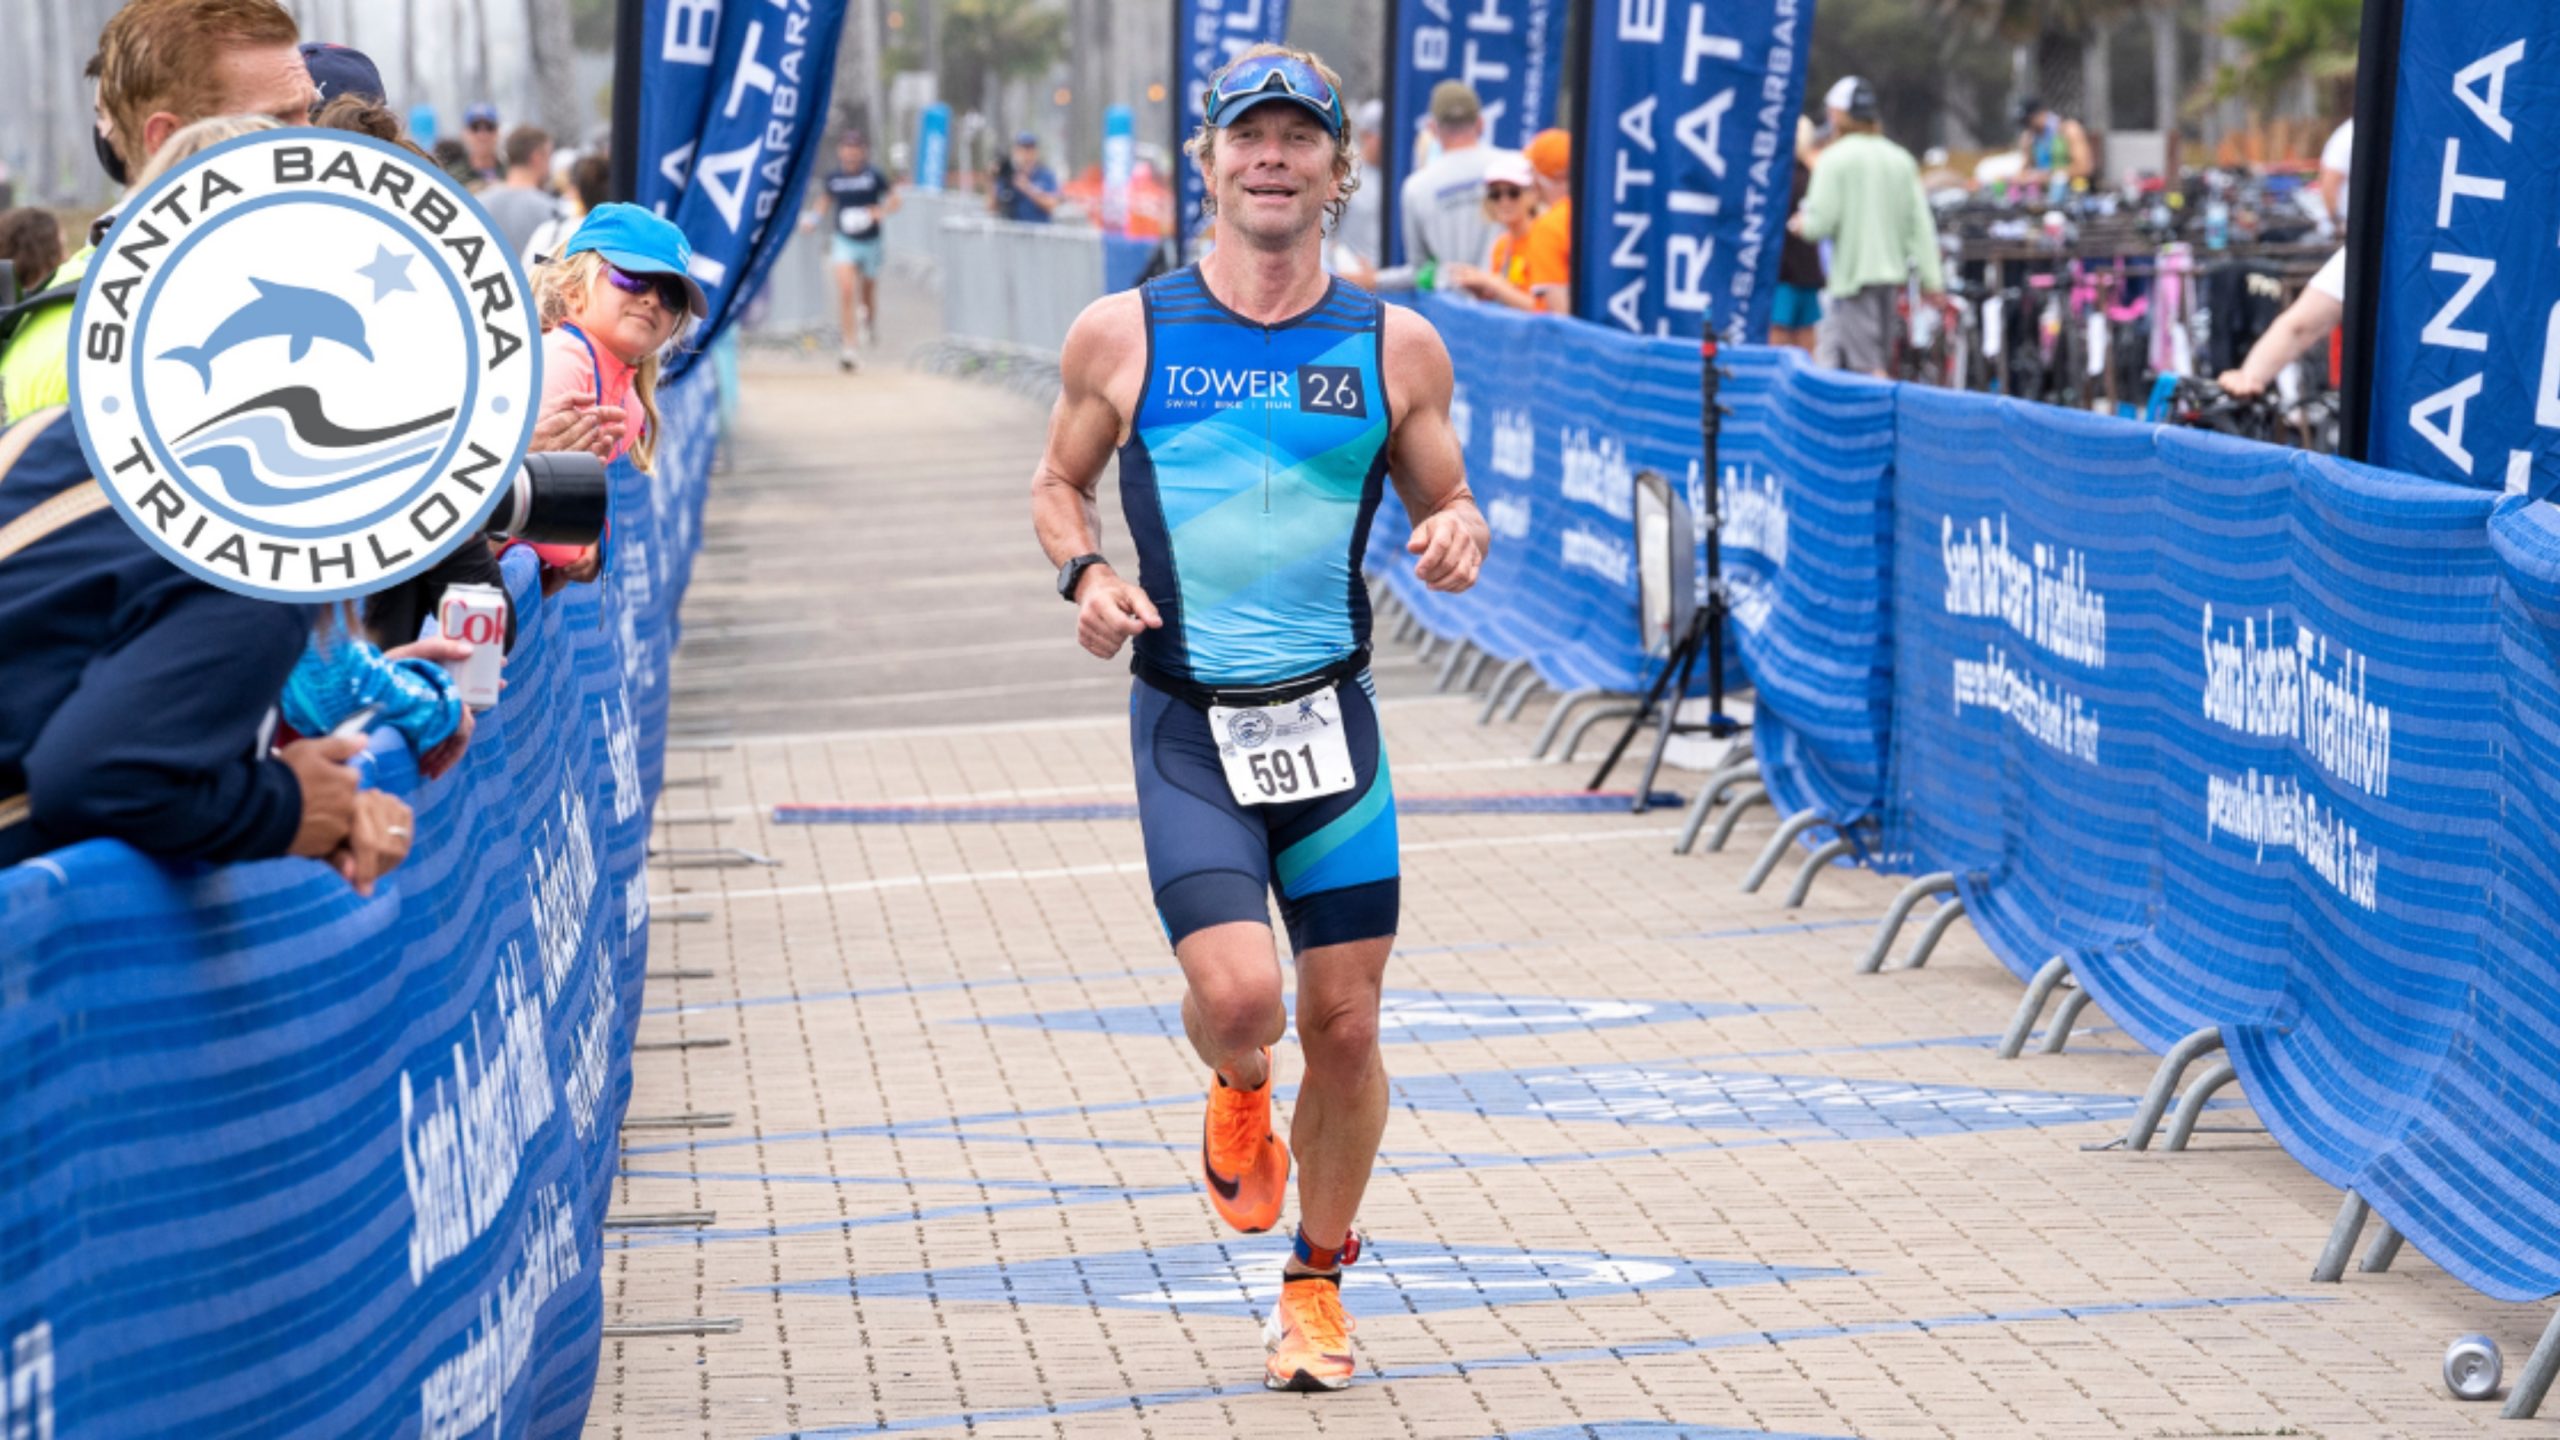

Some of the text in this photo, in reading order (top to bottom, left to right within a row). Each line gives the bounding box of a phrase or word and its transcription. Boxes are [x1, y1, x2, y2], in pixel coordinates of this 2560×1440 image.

[689, 0, 787, 288] IAT
[1656, 2, 1743, 338] RIAT
[2408, 38, 2527, 476] ANTA
[1165, 365, 1358, 410] TOWER 26
[1248, 743, 1320, 796] 591
[2297, 624, 2390, 798] Triathlon
